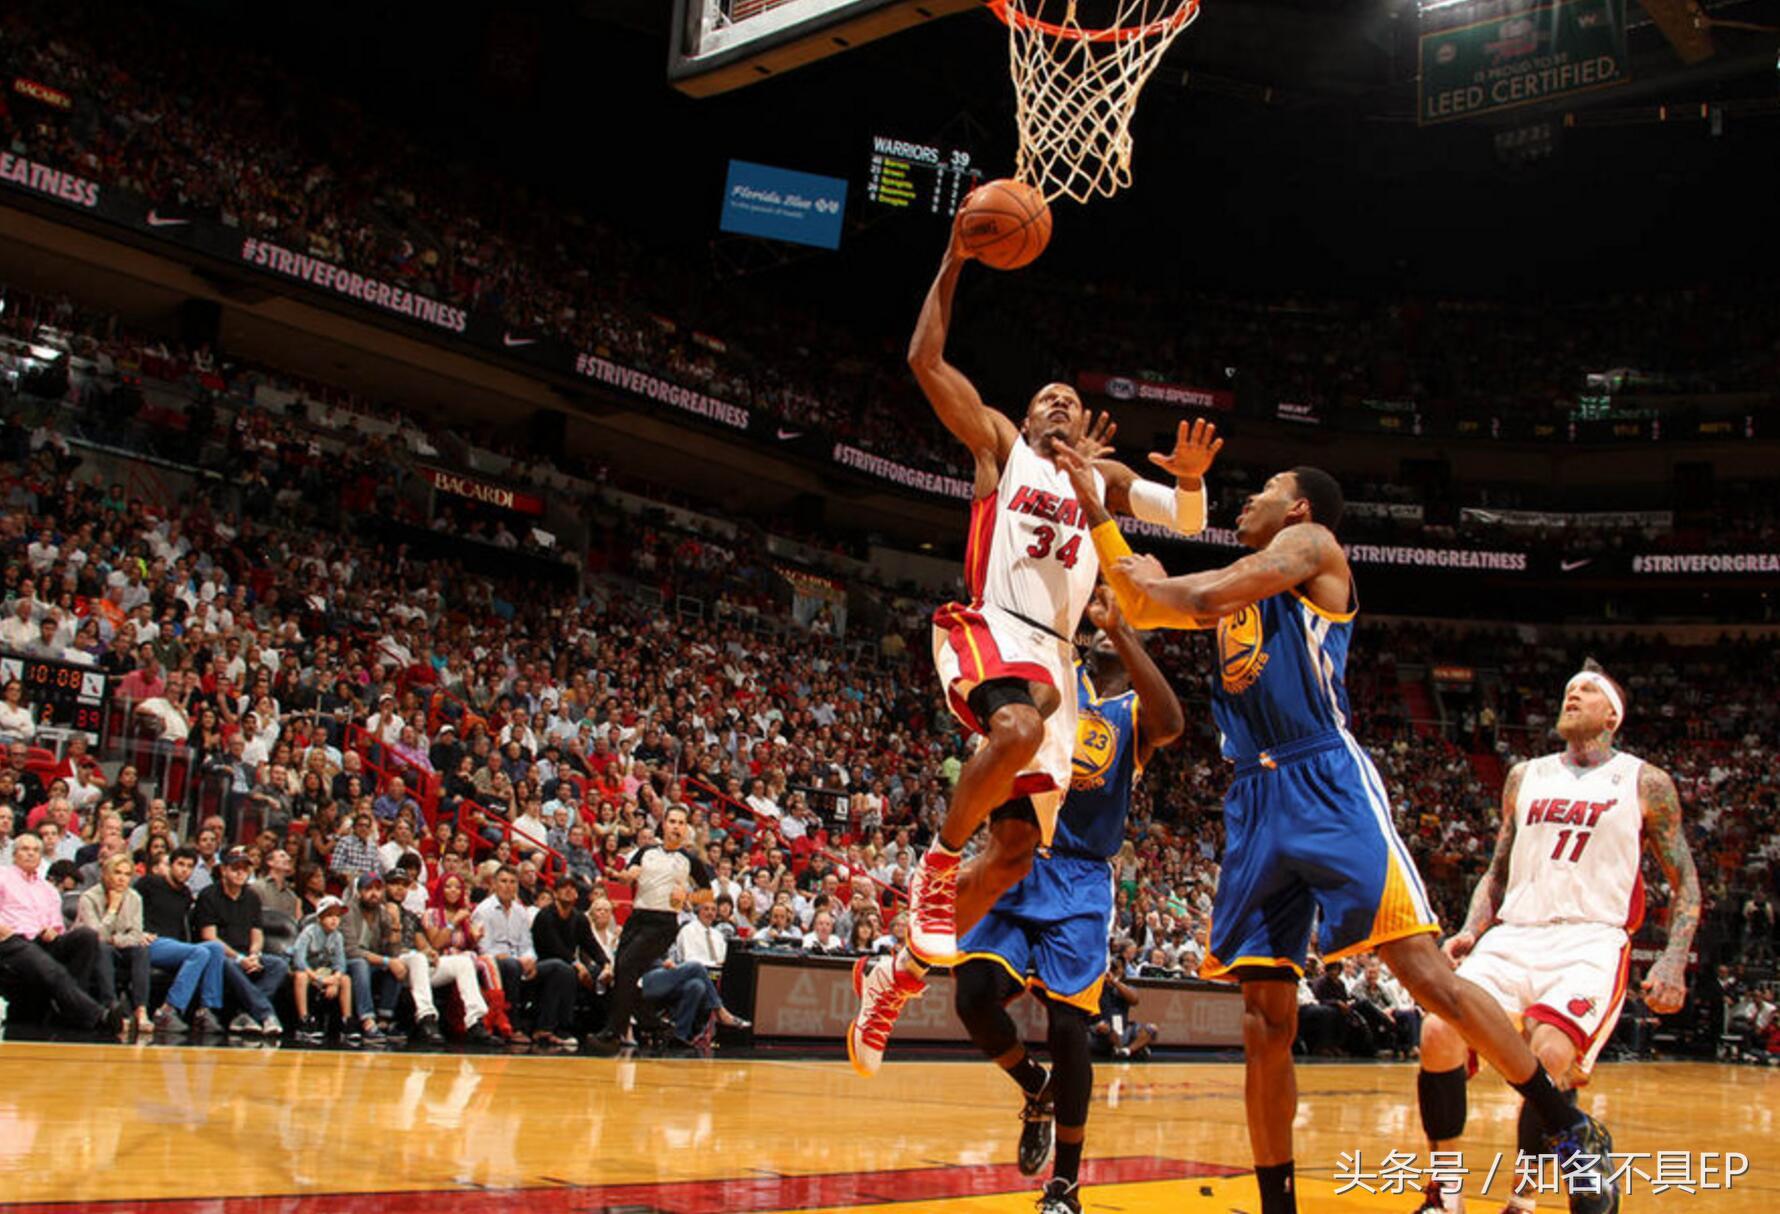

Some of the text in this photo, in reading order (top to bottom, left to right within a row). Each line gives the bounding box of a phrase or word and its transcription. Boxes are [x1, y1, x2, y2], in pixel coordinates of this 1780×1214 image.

[1427, 55, 1621, 117] LEED CERTIFIED.
[873, 136, 971, 167] WARRIORS 39
[242, 238, 467, 332] #STRIVEFORGREATNESS
[576, 353, 750, 429] #STRIVEFORGREATNESS
[435, 471, 514, 509] BACARDI
[1027, 525, 1082, 570] 34
[30, 664, 81, 689] 10:08
[1083, 730, 1109, 751] 23
[1526, 798, 1618, 828] HEAT
[1551, 829, 1592, 863] 11
